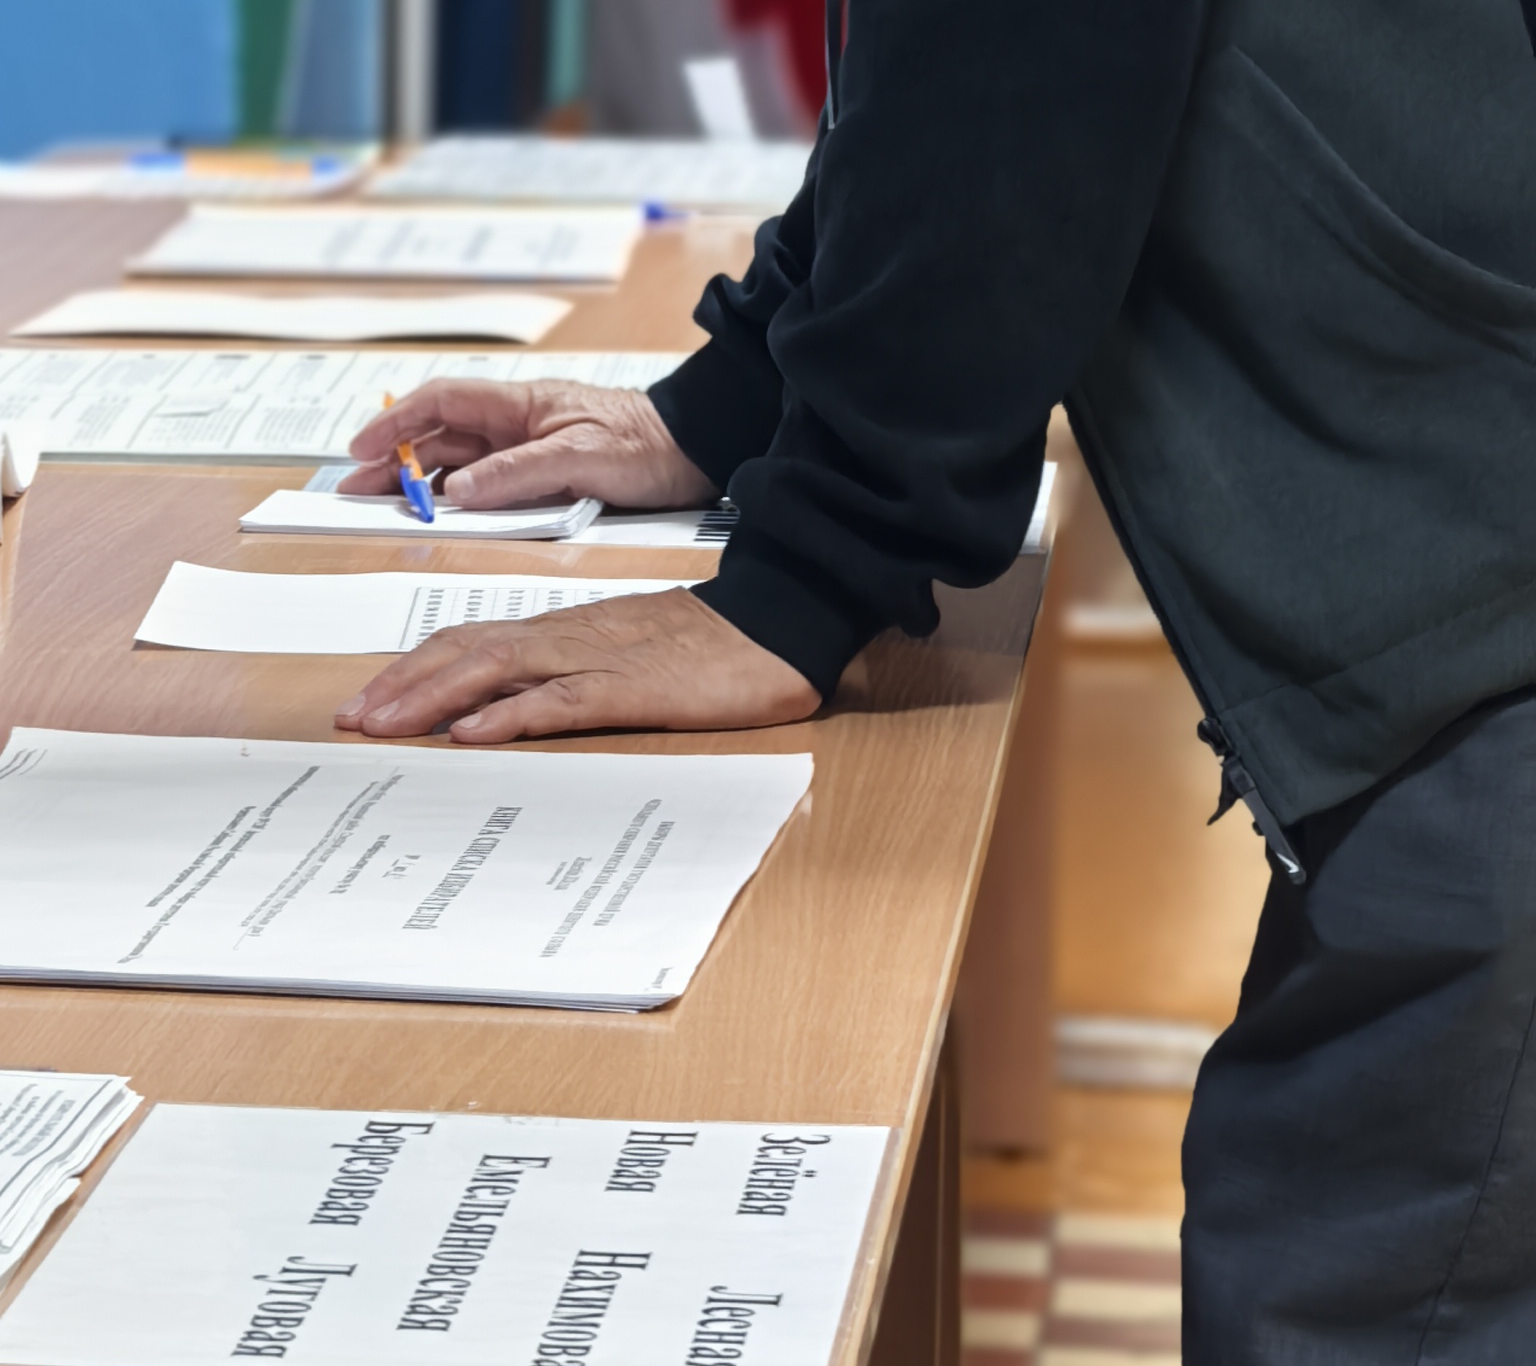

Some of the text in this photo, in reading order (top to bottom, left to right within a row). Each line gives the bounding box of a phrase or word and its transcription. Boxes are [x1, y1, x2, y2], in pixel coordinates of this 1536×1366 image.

[402, 807, 523, 929] КНИГА СПИСКА ИЗБИРАТЕЛЕЙ
[606, 1131, 697, 1192] Новая
[737, 1135, 830, 1216] Зелёная
[232, 1121, 433, 1357] Березовая Луговая
[397, 1155, 550, 1331] Емельяновская
